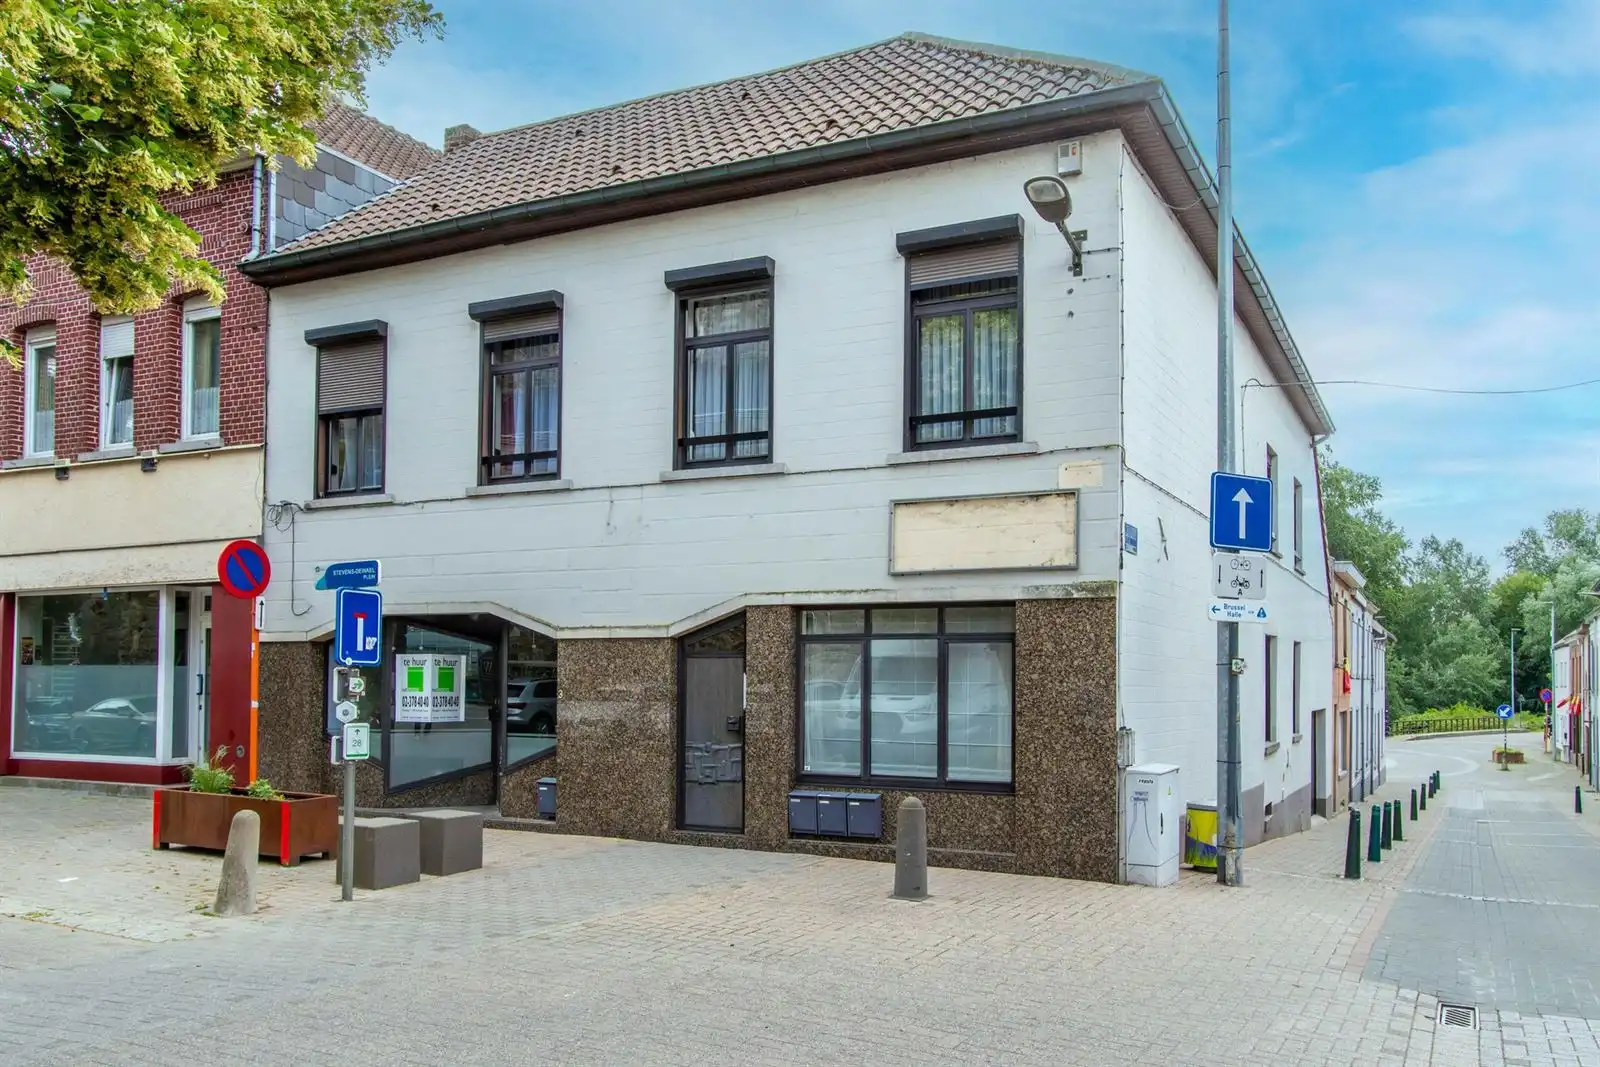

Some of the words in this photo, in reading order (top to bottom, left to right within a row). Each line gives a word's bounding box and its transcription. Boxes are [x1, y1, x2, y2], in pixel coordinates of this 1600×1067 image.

[1237, 588, 1243, 596] A
[1223, 602, 1246, 611] Brussel
[403, 658, 411, 666] te
[412, 656, 427, 666] huur
[434, 658, 441, 666] te
[442, 657, 458, 667] huur
[352, 739, 362, 747] 28
